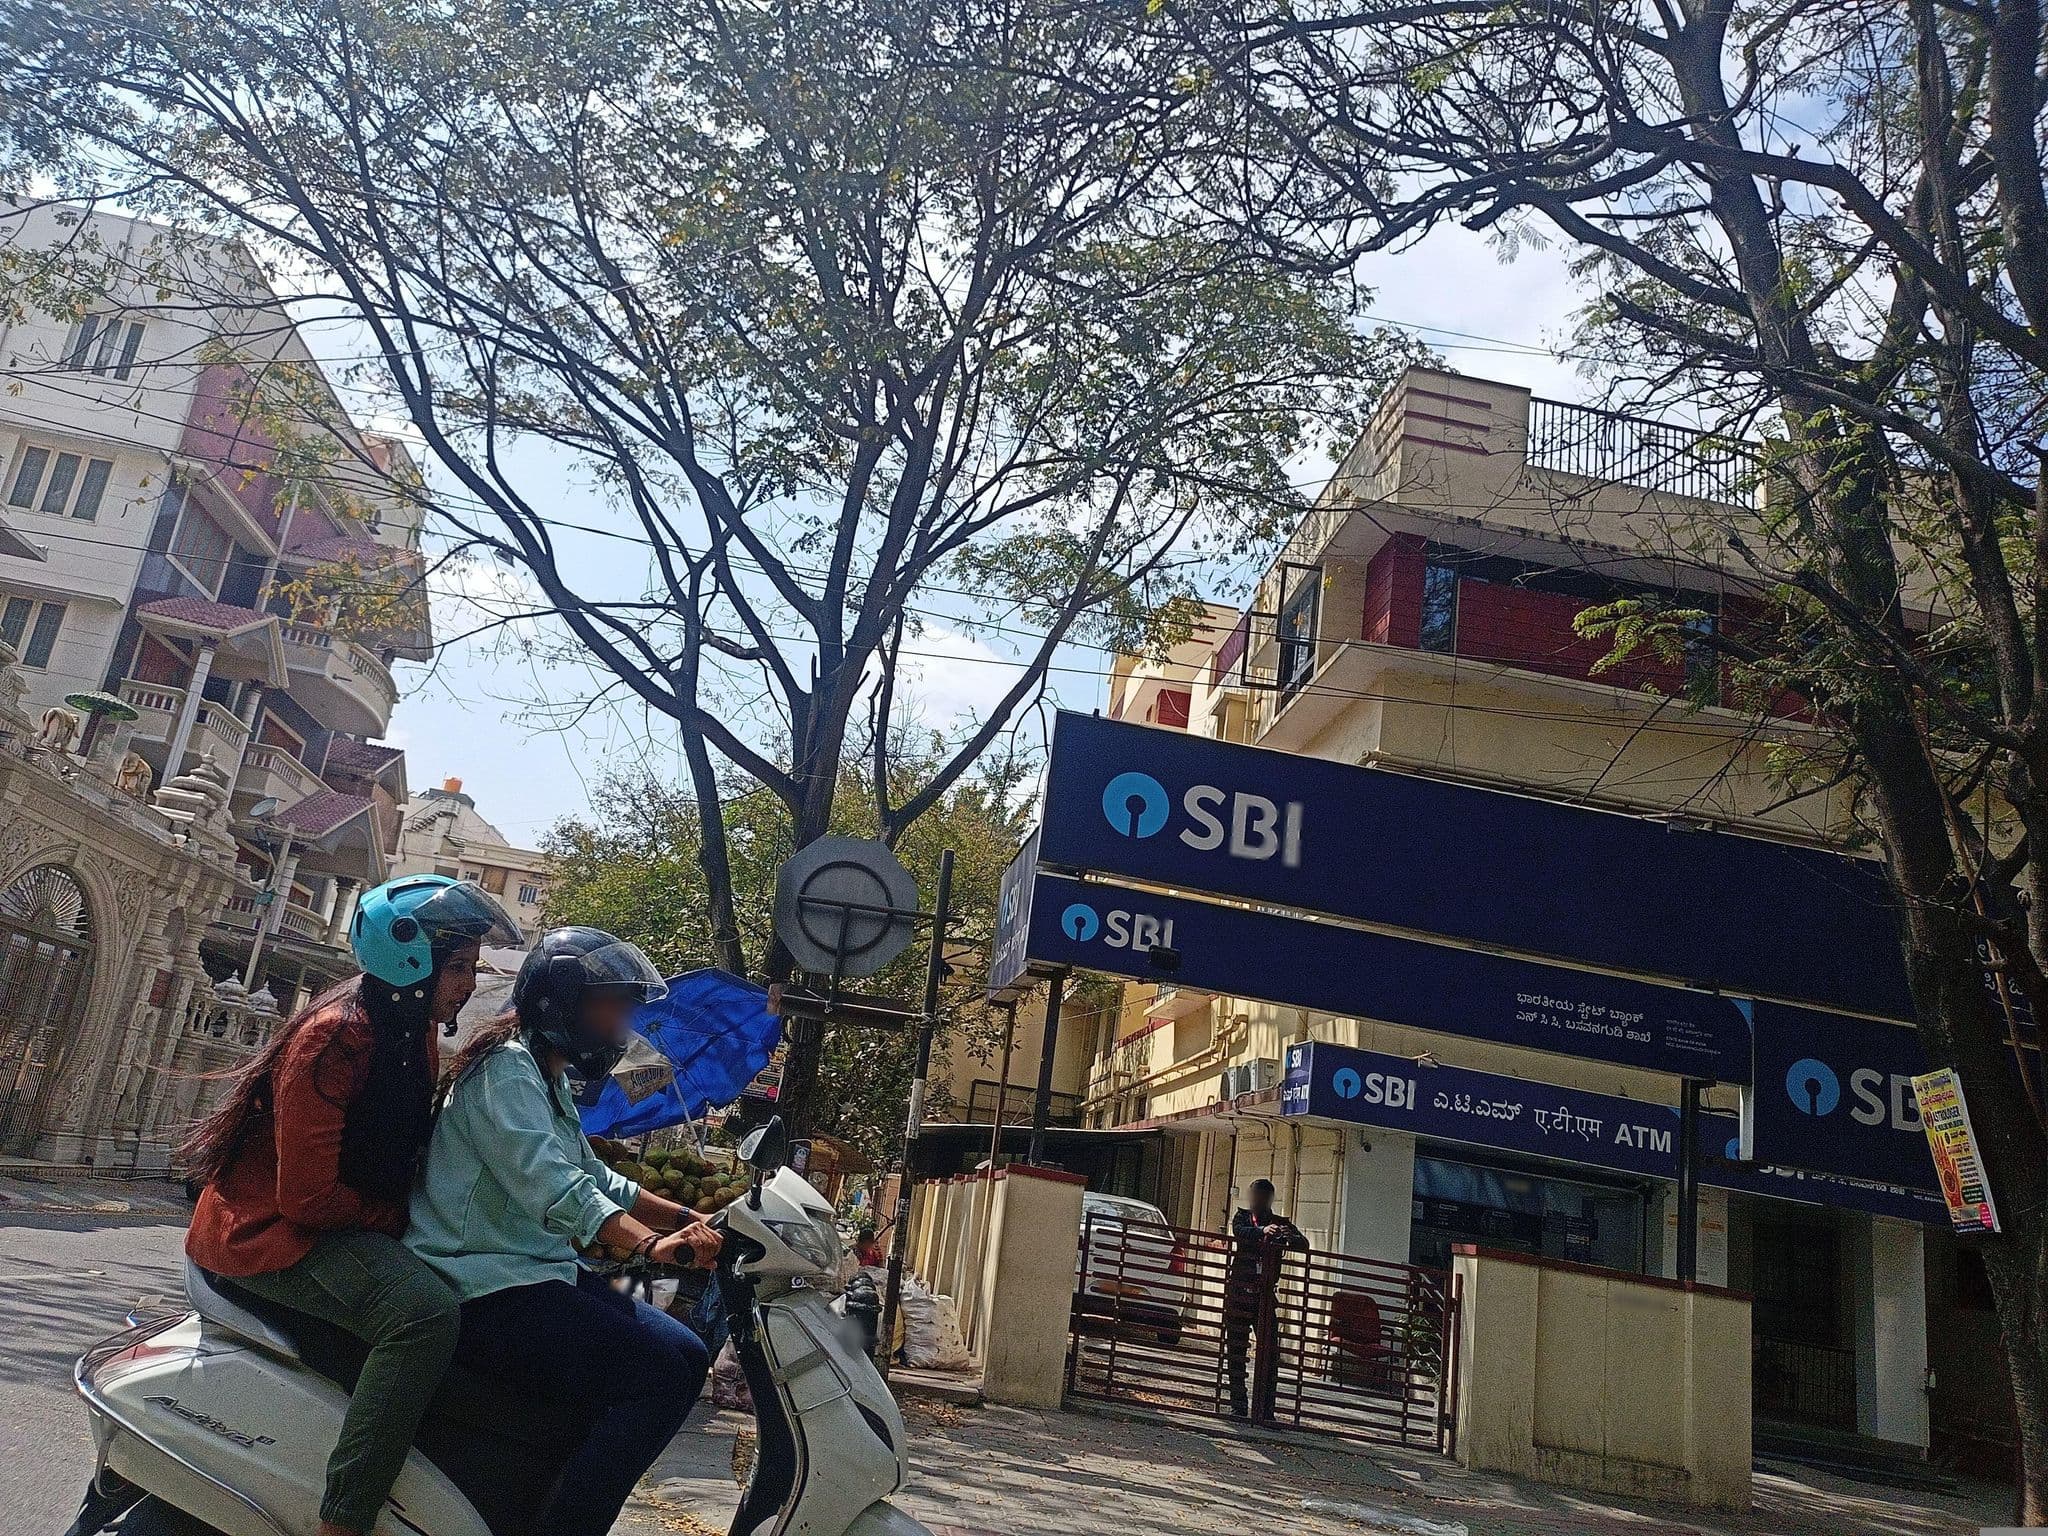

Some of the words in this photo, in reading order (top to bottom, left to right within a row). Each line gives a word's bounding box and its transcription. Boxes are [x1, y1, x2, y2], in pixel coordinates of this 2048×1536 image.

[1180, 785, 1302, 867] SBI
[1104, 910, 1174, 952] SBI
[1516, 992, 1574, 1012] ಭಾರತೀಯ
[1609, 1008, 1645, 1028] ಬ್ಯಾಂಕ್
[1364, 1072, 1417, 1111] SBI
[1850, 1068, 1925, 1132] SB
[1534, 1106, 1603, 1142] ए.टी.एम
[1614, 1123, 1672, 1153] ATM
